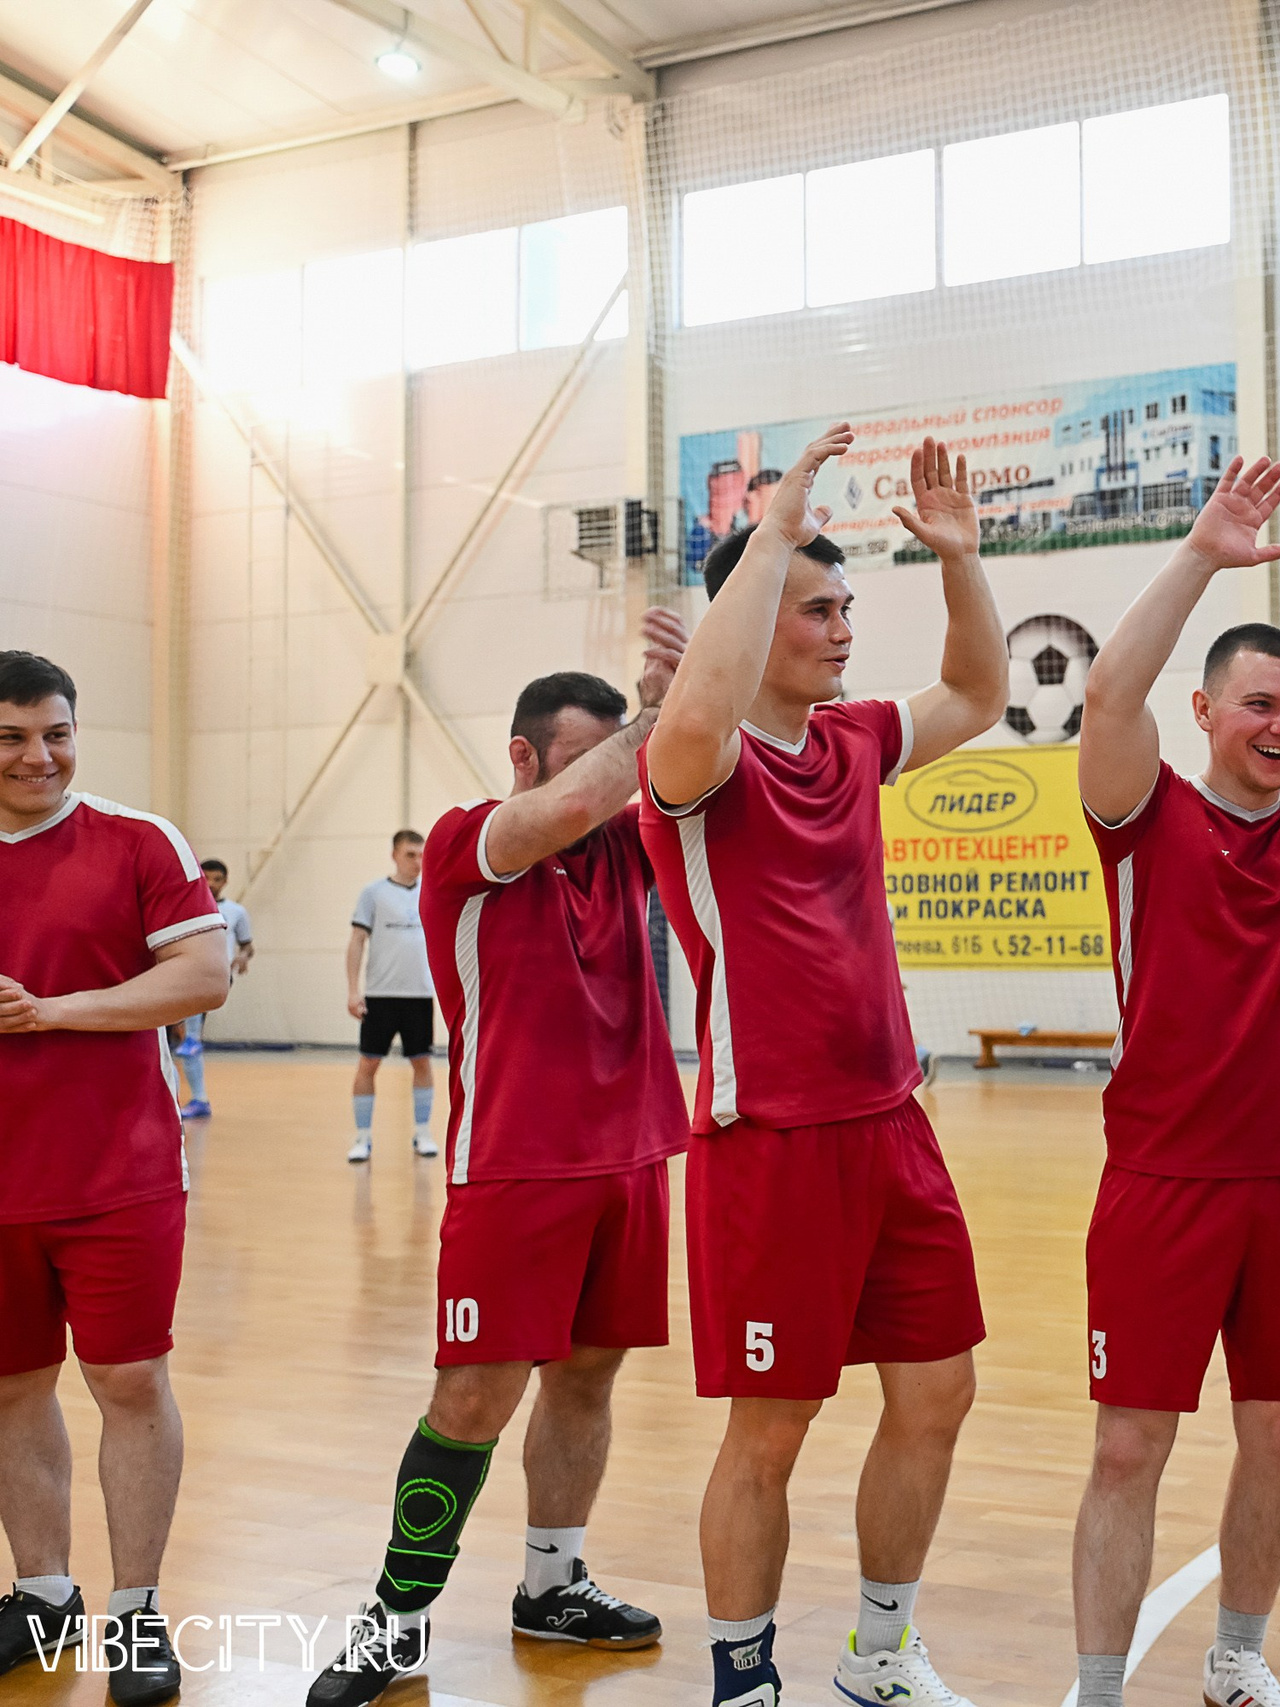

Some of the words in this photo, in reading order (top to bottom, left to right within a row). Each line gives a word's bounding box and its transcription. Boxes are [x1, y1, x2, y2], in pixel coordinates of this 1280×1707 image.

[972, 398, 1063, 423] спонсор
[928, 792, 1017, 816] ЛИДЕР
[886, 867, 979, 894] ЗОВНОЙ
[990, 870, 1090, 893] РЕМОНТ
[918, 897, 1046, 920] ПОКРАСКА
[1008, 934, 1104, 957] 52-11-68
[445, 1297, 479, 1343] 10
[746, 1321, 775, 1372] 5
[1092, 1329, 1107, 1380] 3
